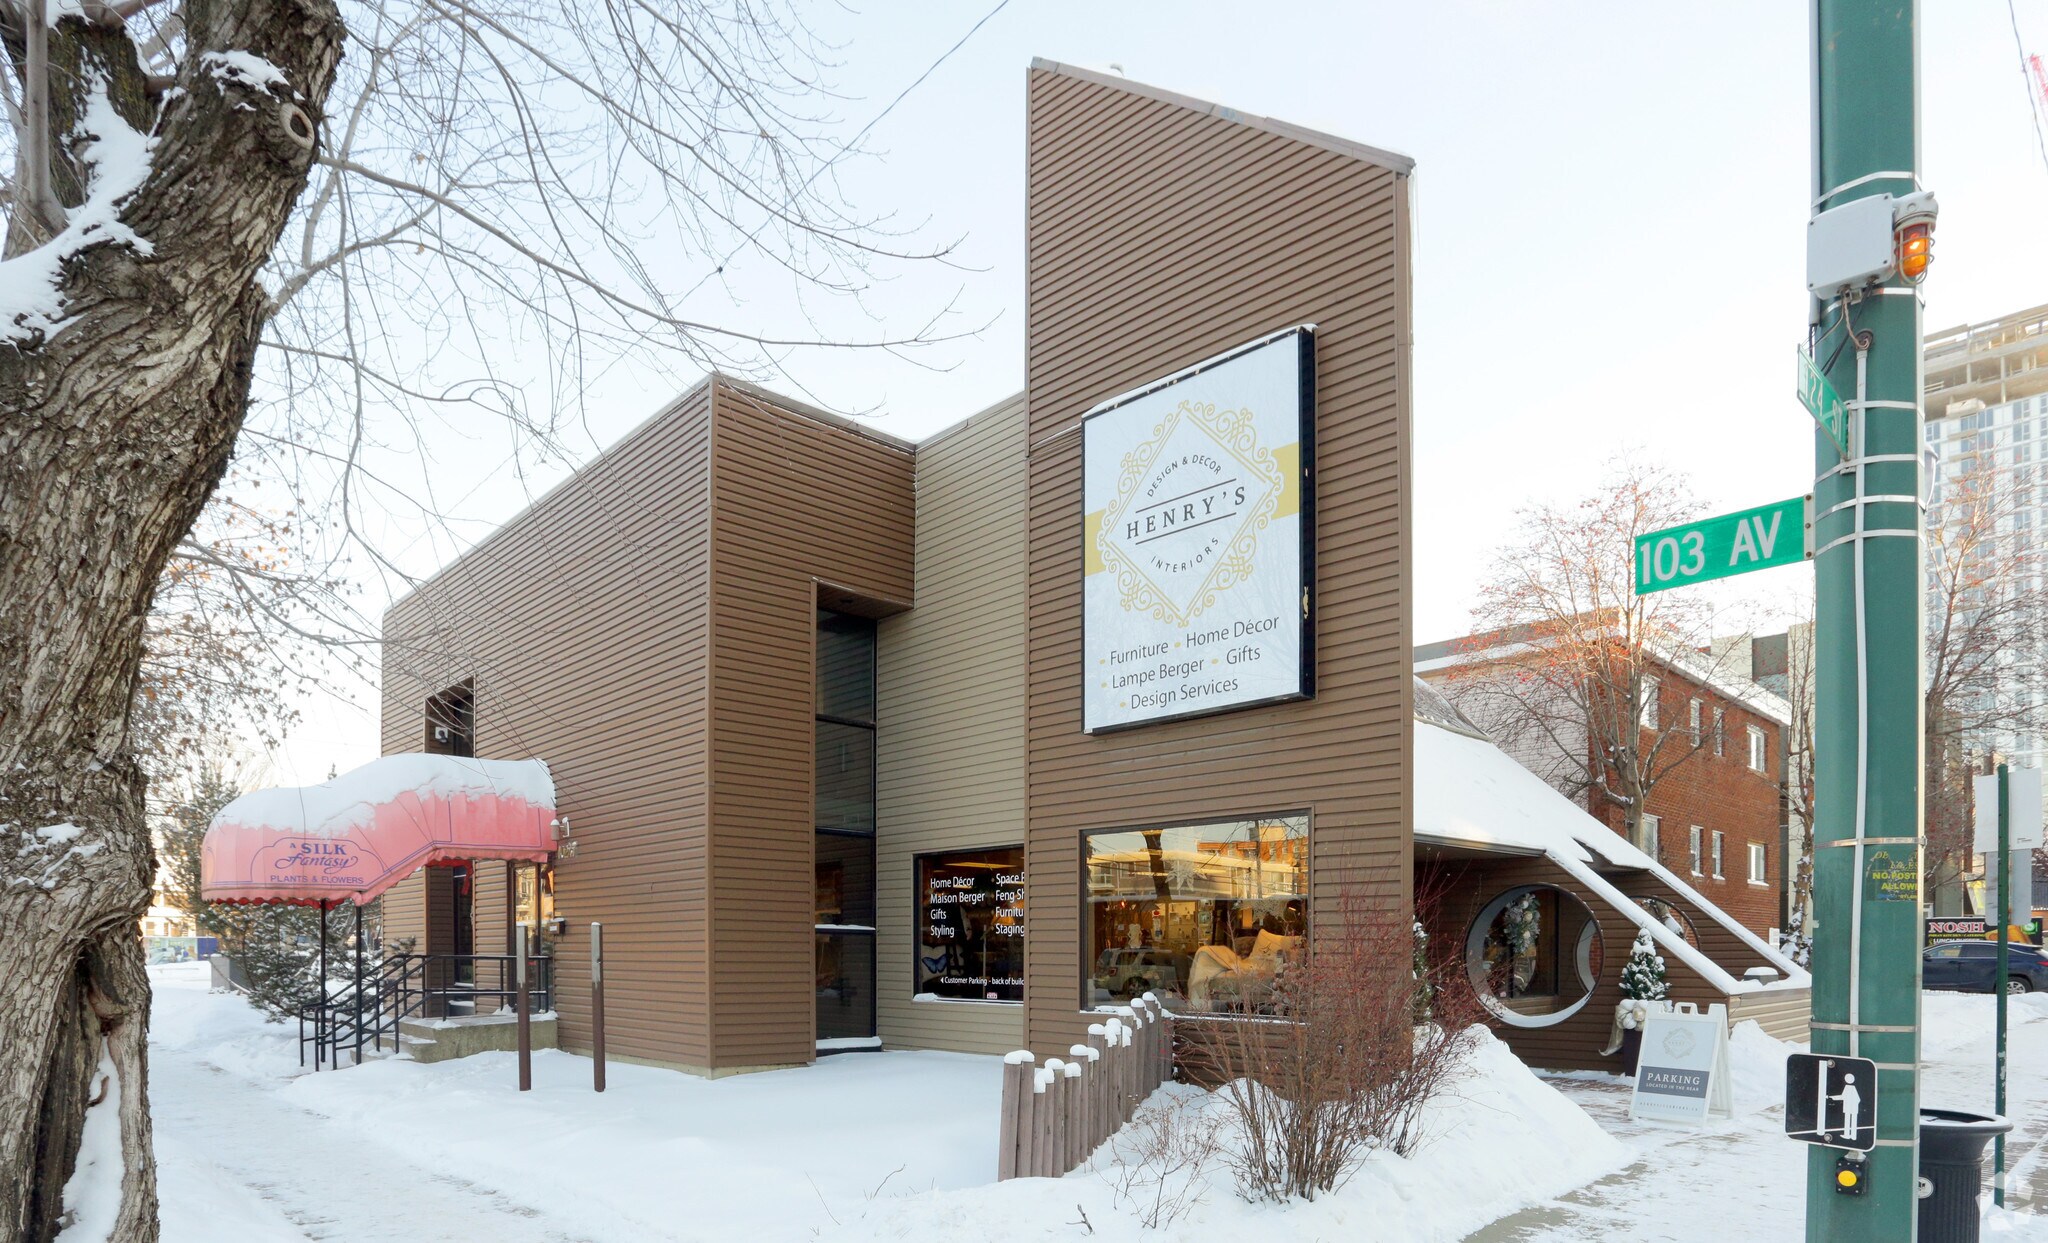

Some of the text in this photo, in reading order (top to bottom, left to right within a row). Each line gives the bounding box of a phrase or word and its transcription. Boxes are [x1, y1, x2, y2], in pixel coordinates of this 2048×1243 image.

[1805, 364, 1843, 441] 124 ST
[1147, 454, 1221, 498] DESIGN & DECOR
[1127, 486, 1245, 540] HENRY'S
[1640, 510, 1782, 585] 103 AV
[1151, 537, 1219, 573] INTERIORS
[1110, 616, 1280, 666] Furniture Home Décor
[1112, 645, 1261, 688] Lampe Berger Gifts
[1131, 678, 1239, 709] Design Services
[301, 843, 347, 855] SILK
[270, 875, 308, 883] PLANTS
[321, 876, 364, 884] FLOWERS
[930, 876, 975, 889] Home Décor
[995, 873, 1020, 887] Space
[1872, 872, 1889, 880] NO
[1881, 882, 1918, 890] ALLOW
[930, 891, 985, 905] Maison Berger
[995, 889, 1015, 903] Feng
[930, 908, 947, 920] Gifts
[930, 924, 955, 938] Styling
[995, 923, 1025, 937] Staging
[1928, 921, 1986, 934] NOSH
[944, 976, 968, 984] Customer
[968, 977, 988, 987] Parking
[992, 977, 1004, 985] back
[1005, 977, 1011, 985] of
[1647, 1072, 1700, 1085] PARKING
